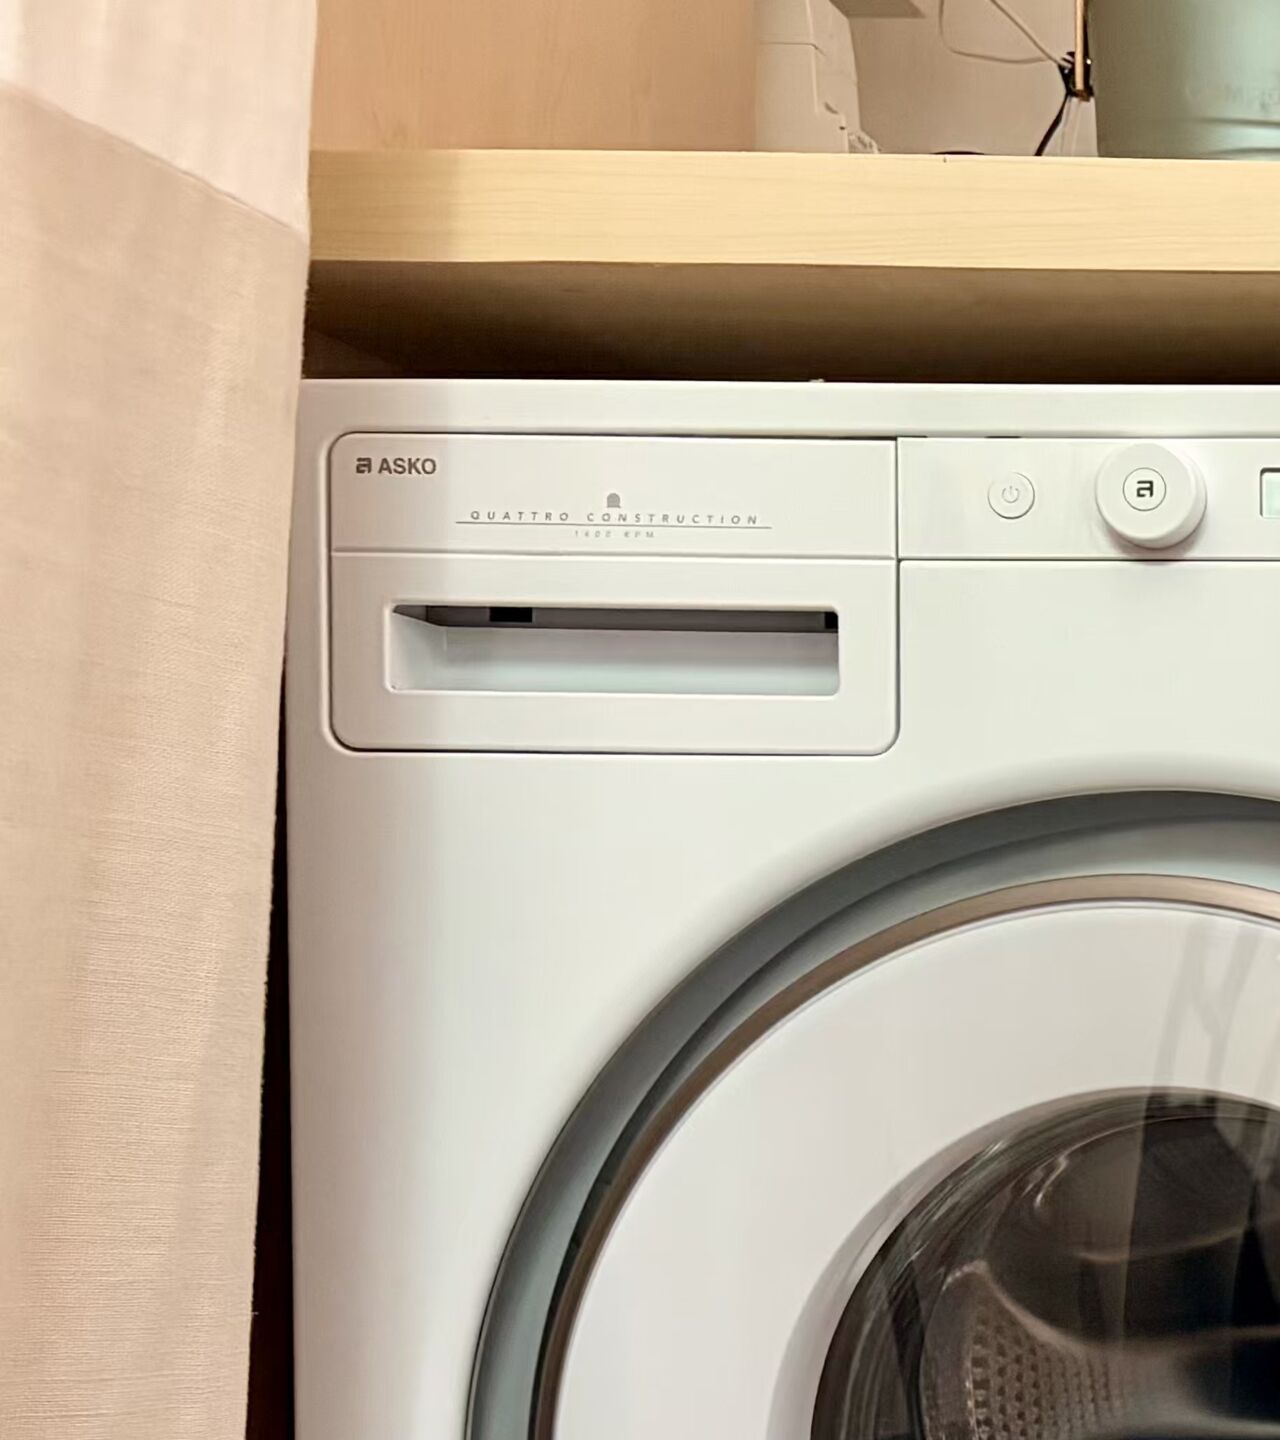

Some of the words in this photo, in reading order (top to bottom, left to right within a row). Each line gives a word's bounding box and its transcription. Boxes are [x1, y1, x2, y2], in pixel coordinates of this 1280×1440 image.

[377, 457, 437, 475] ASKO
[470, 510, 569, 522] QUATTRO
[587, 512, 758, 525] CONSTRUCTION
